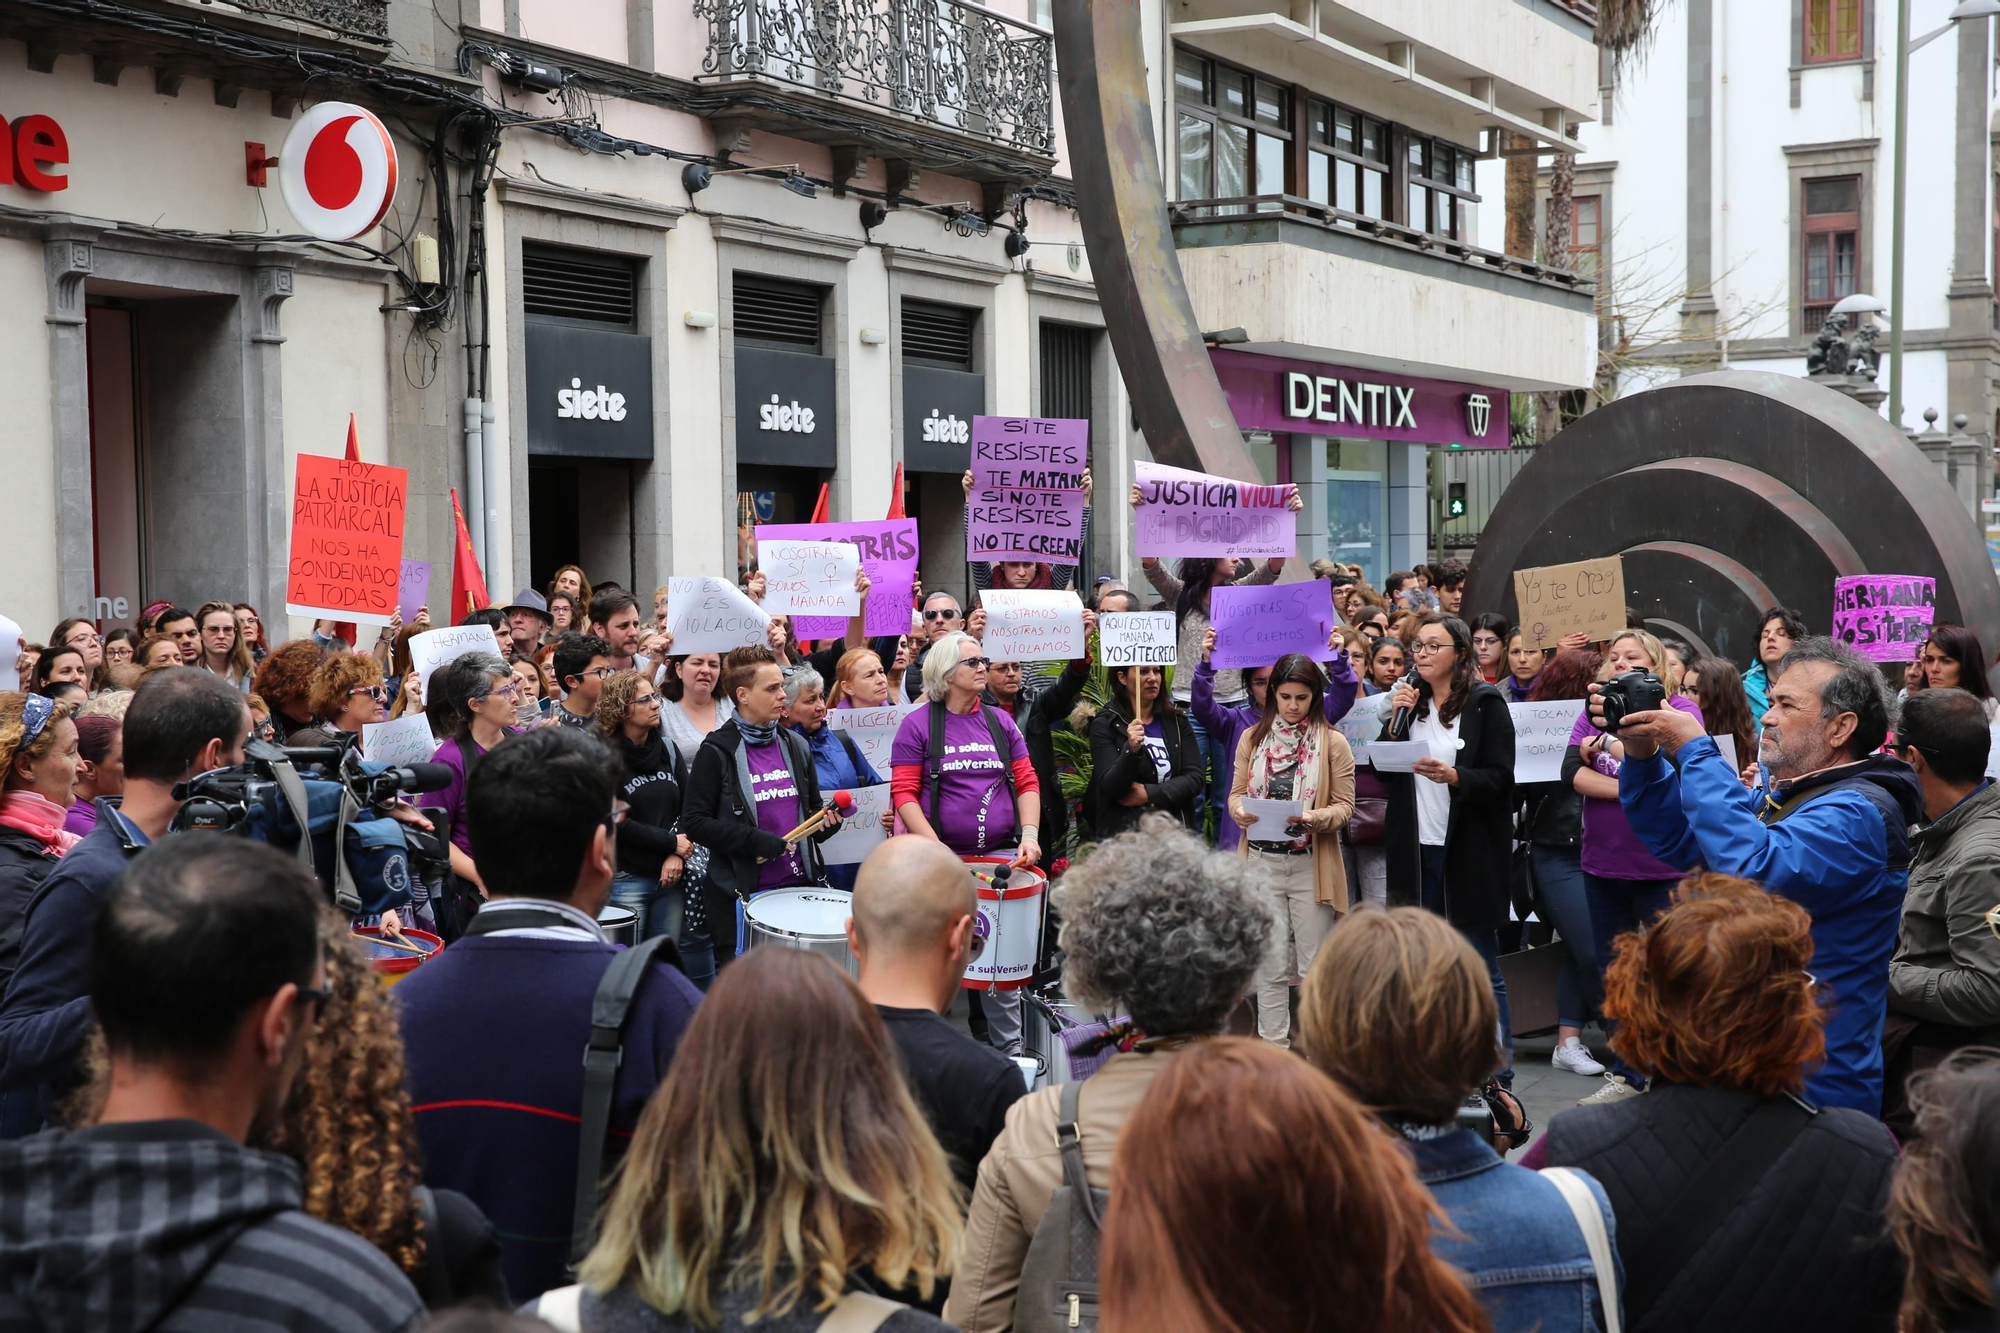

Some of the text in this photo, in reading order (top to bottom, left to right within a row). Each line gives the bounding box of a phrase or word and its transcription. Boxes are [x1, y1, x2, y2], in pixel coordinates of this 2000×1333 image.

[557, 377, 628, 422] siete
[1287, 371, 1418, 429] DENTIX
[759, 393, 816, 434] siete
[922, 408, 969, 444] siete
[1033, 422, 1056, 435] TE
[977, 441, 1079, 464] RESISTES
[338, 460, 375, 478] HOY
[986, 469, 1081, 489] TE MATAN
[297, 477, 403, 510] LA JUSTICIA
[1145, 479, 1237, 509] JUSTICIA
[295, 499, 399, 538] PATRIARCAL
[972, 505, 1072, 527] RESISTES
[1175, 511, 1281, 544] DIGNIDAD
[311, 538, 381, 561] NOS HA
[770, 545, 844, 560] NOSOTRAS
[973, 532, 1080, 557] NO TE CREEN
[289, 557, 397, 587] CONDENADO
[293, 582, 307, 602] A
[316, 583, 387, 608] TODAS
[672, 579, 693, 594] NO
[702, 580, 722, 593] ES
[767, 580, 811, 593] SOMOS
[1521, 570, 1542, 604] Yo
[1548, 579, 1567, 600] te
[1835, 581, 1936, 612] HERMANA
[702, 596, 730, 610] ES
[790, 594, 846, 608] MANADA
[1004, 607, 1059, 620] ESTAMOS
[1104, 616, 1171, 630] AQUÍ ESTÁ TU
[991, 624, 1072, 638] NOSOTRAS NO
[1119, 631, 1156, 643] MANADA
[1002, 640, 1072, 656] VIOLAMOS
[1530, 709, 1575, 719] TOCAN
[366, 723, 429, 748] NOSOTRAS
[390, 738, 429, 758] SOMOS
[944, 745, 956, 755] la
[1523, 744, 1566, 755] TODAS
[942, 758, 1005, 771] subVersiva
